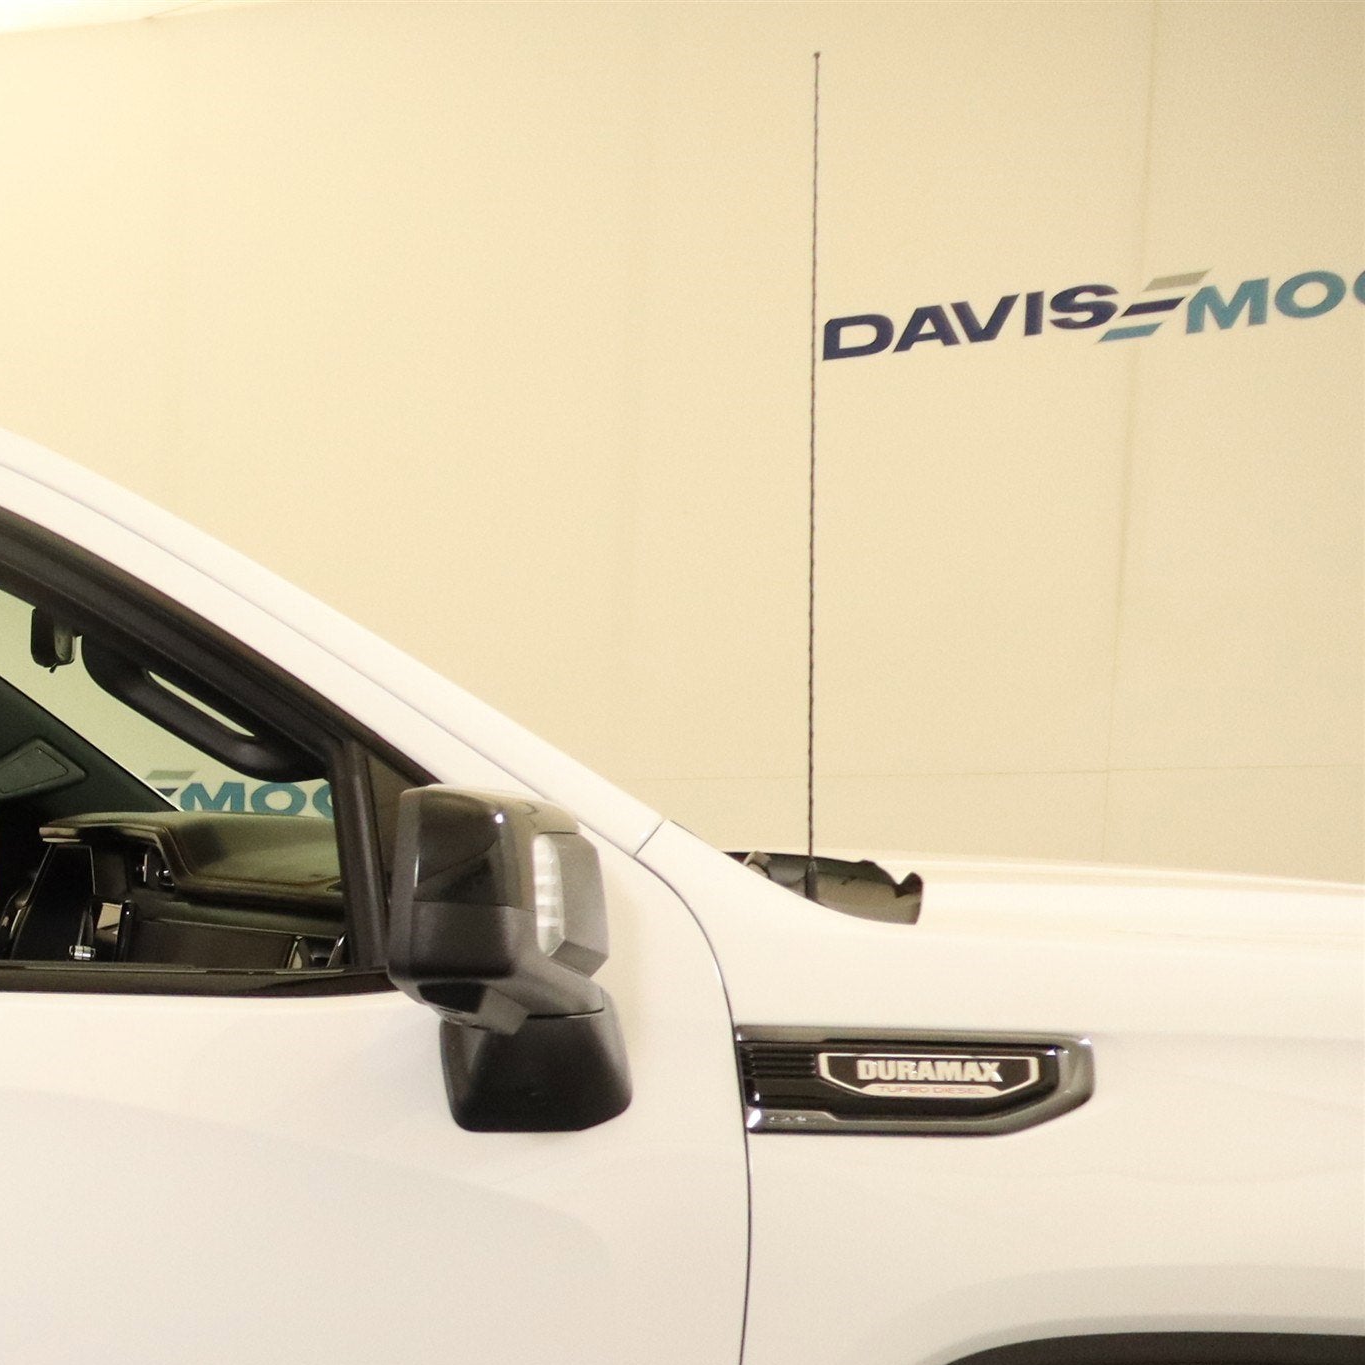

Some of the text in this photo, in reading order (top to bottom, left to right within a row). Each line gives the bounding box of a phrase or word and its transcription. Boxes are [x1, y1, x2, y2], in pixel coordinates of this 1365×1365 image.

[822, 269, 1365, 361] DAVIS MO
[856, 1059, 1003, 1082] DURAMAX
[932, 1086, 985, 1095] DIESEL
